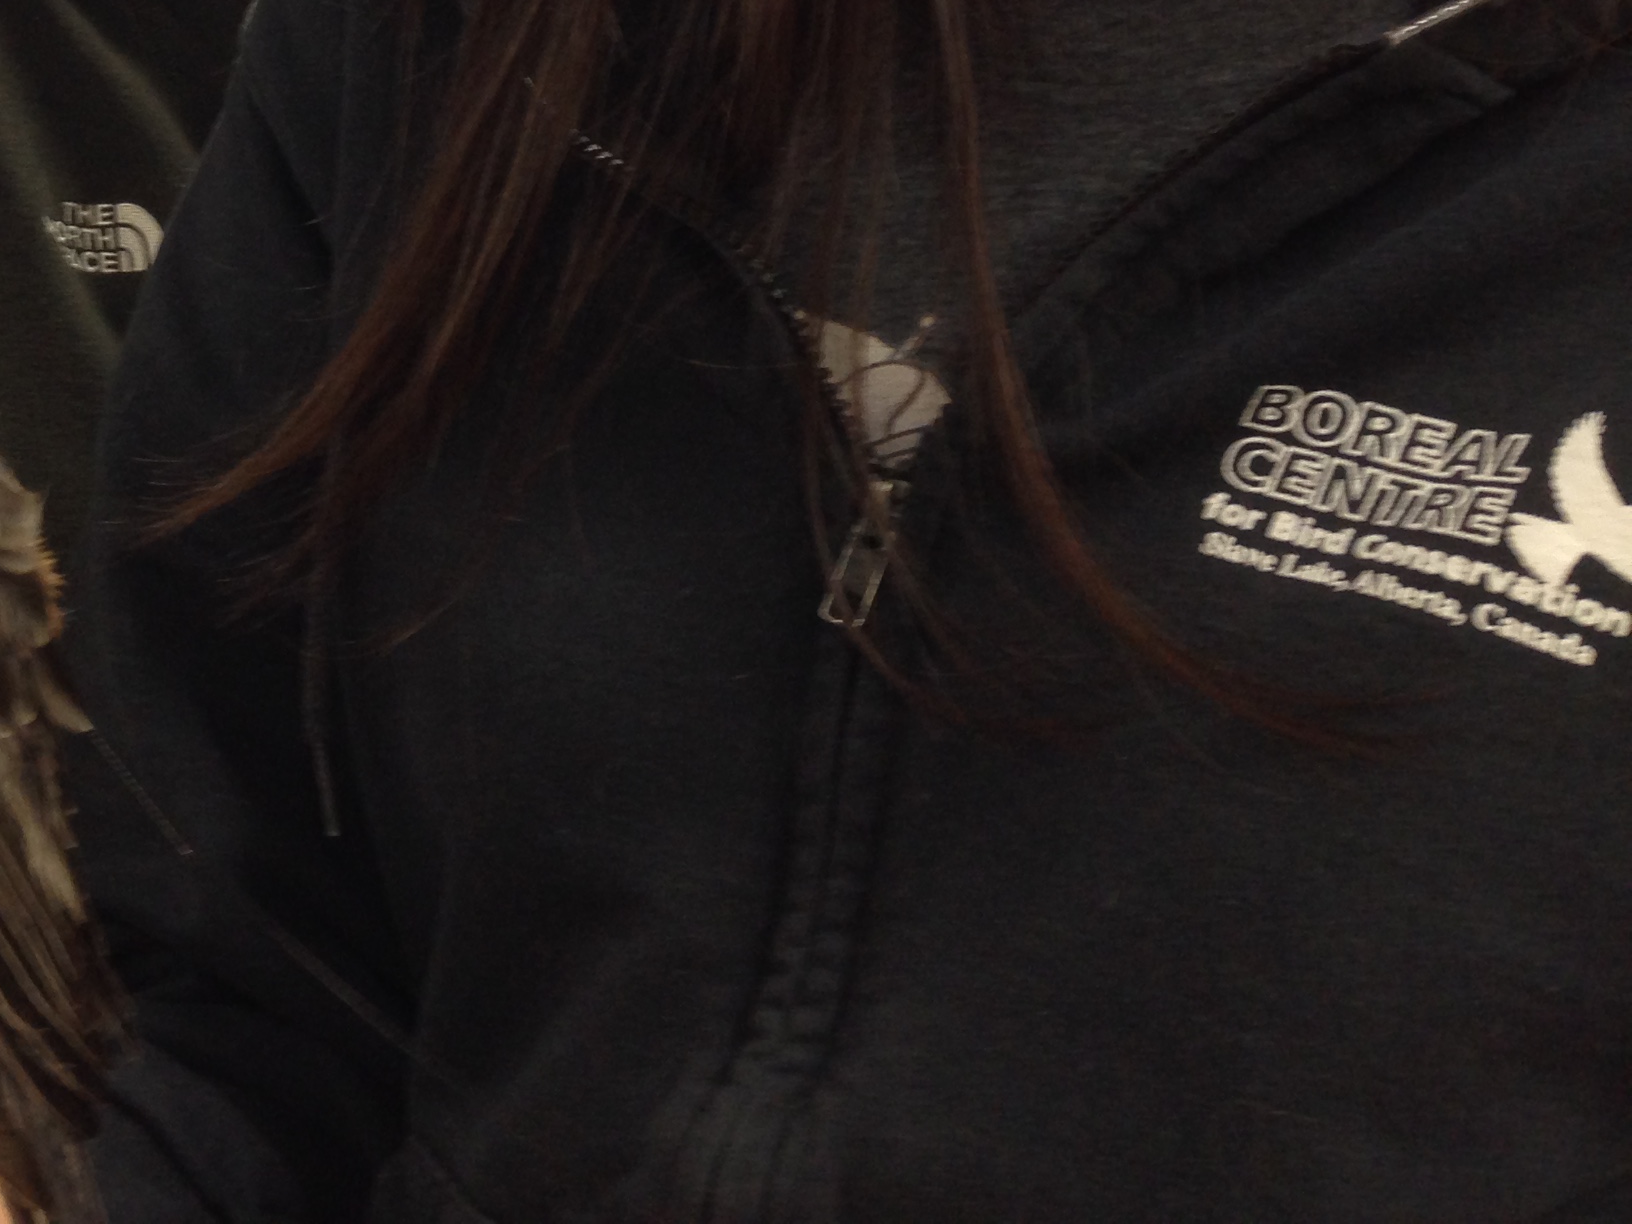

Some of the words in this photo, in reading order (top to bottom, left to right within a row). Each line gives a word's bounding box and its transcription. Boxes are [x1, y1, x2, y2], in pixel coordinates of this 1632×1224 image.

[62, 201, 114, 225] THE
[1239, 384, 1532, 484] BOREAL
[1220, 437, 1516, 546] CENTRE
[1201, 492, 1266, 530] for
[1267, 511, 1357, 555] Bird
[1353, 535, 1632, 638] Conservation
[1471, 603, 1597, 666] Canada
